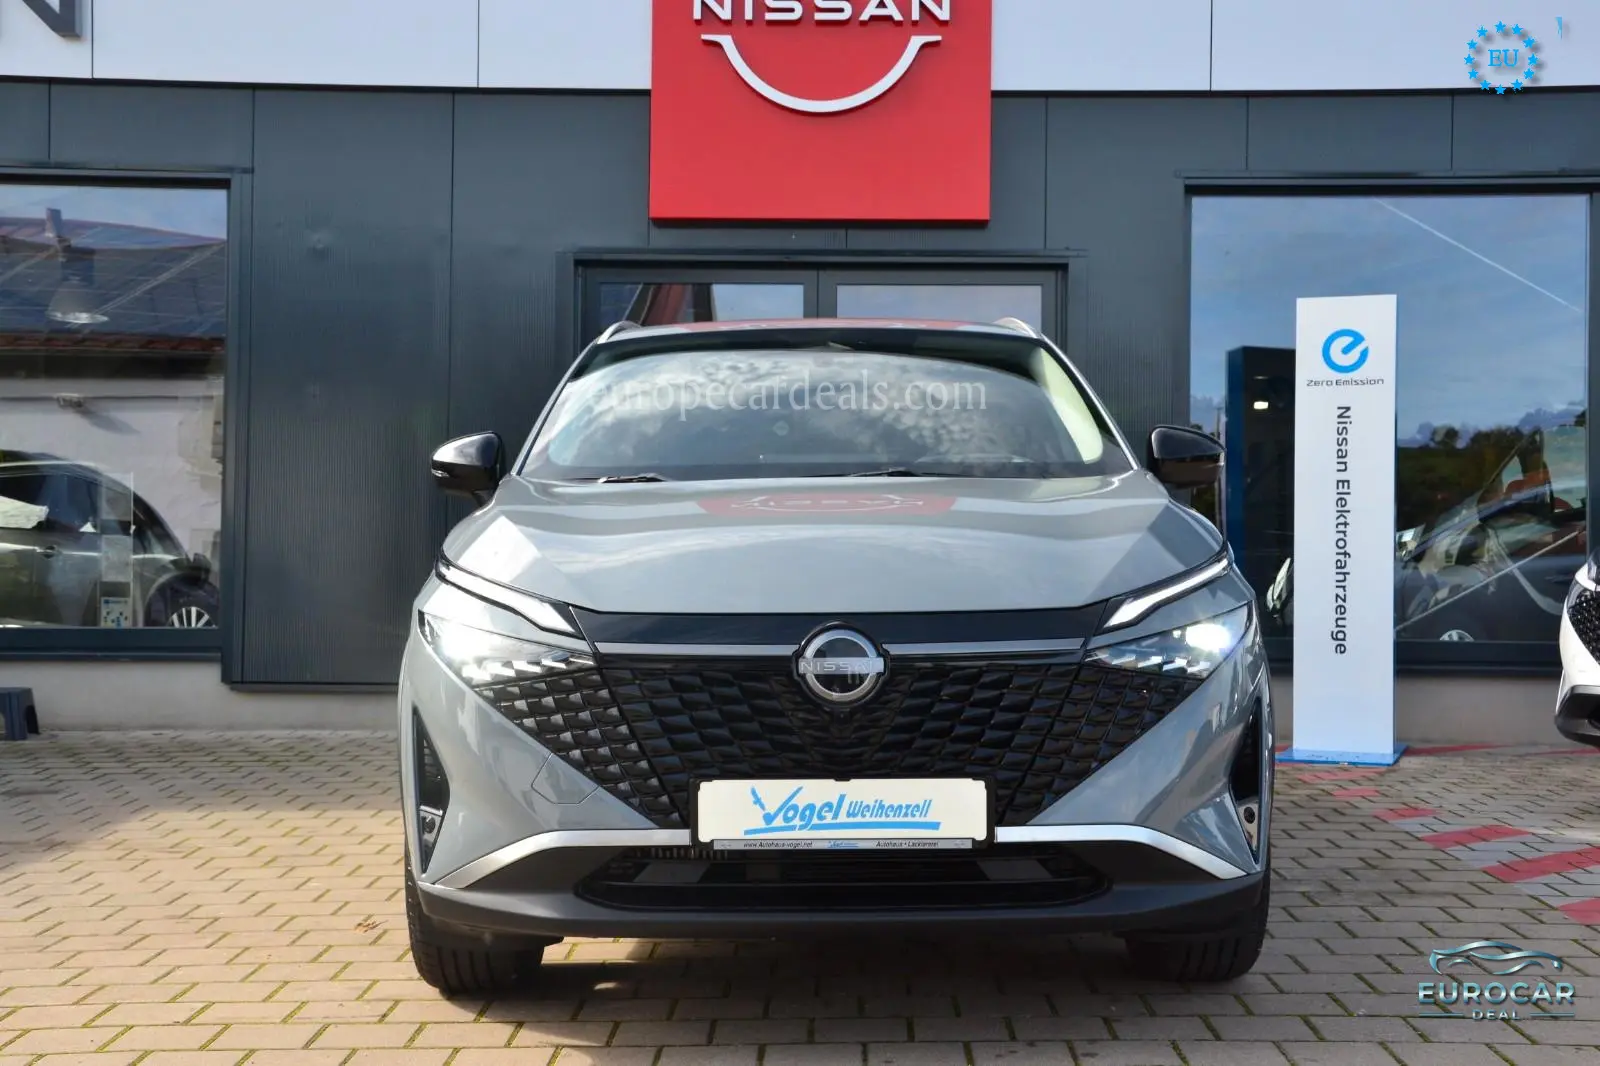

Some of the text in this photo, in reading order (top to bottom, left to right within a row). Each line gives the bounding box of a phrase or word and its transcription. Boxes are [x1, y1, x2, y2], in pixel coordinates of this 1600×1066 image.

[693, 0, 950, 21] NISSAN
[1306, 377, 1385, 387] Zero Emission
[1331, 406, 1352, 654] Nissan Elektrofahrzeuge
[801, 661, 882, 672] NISSA
[750, 786, 932, 831] Vogel Weihenzell
